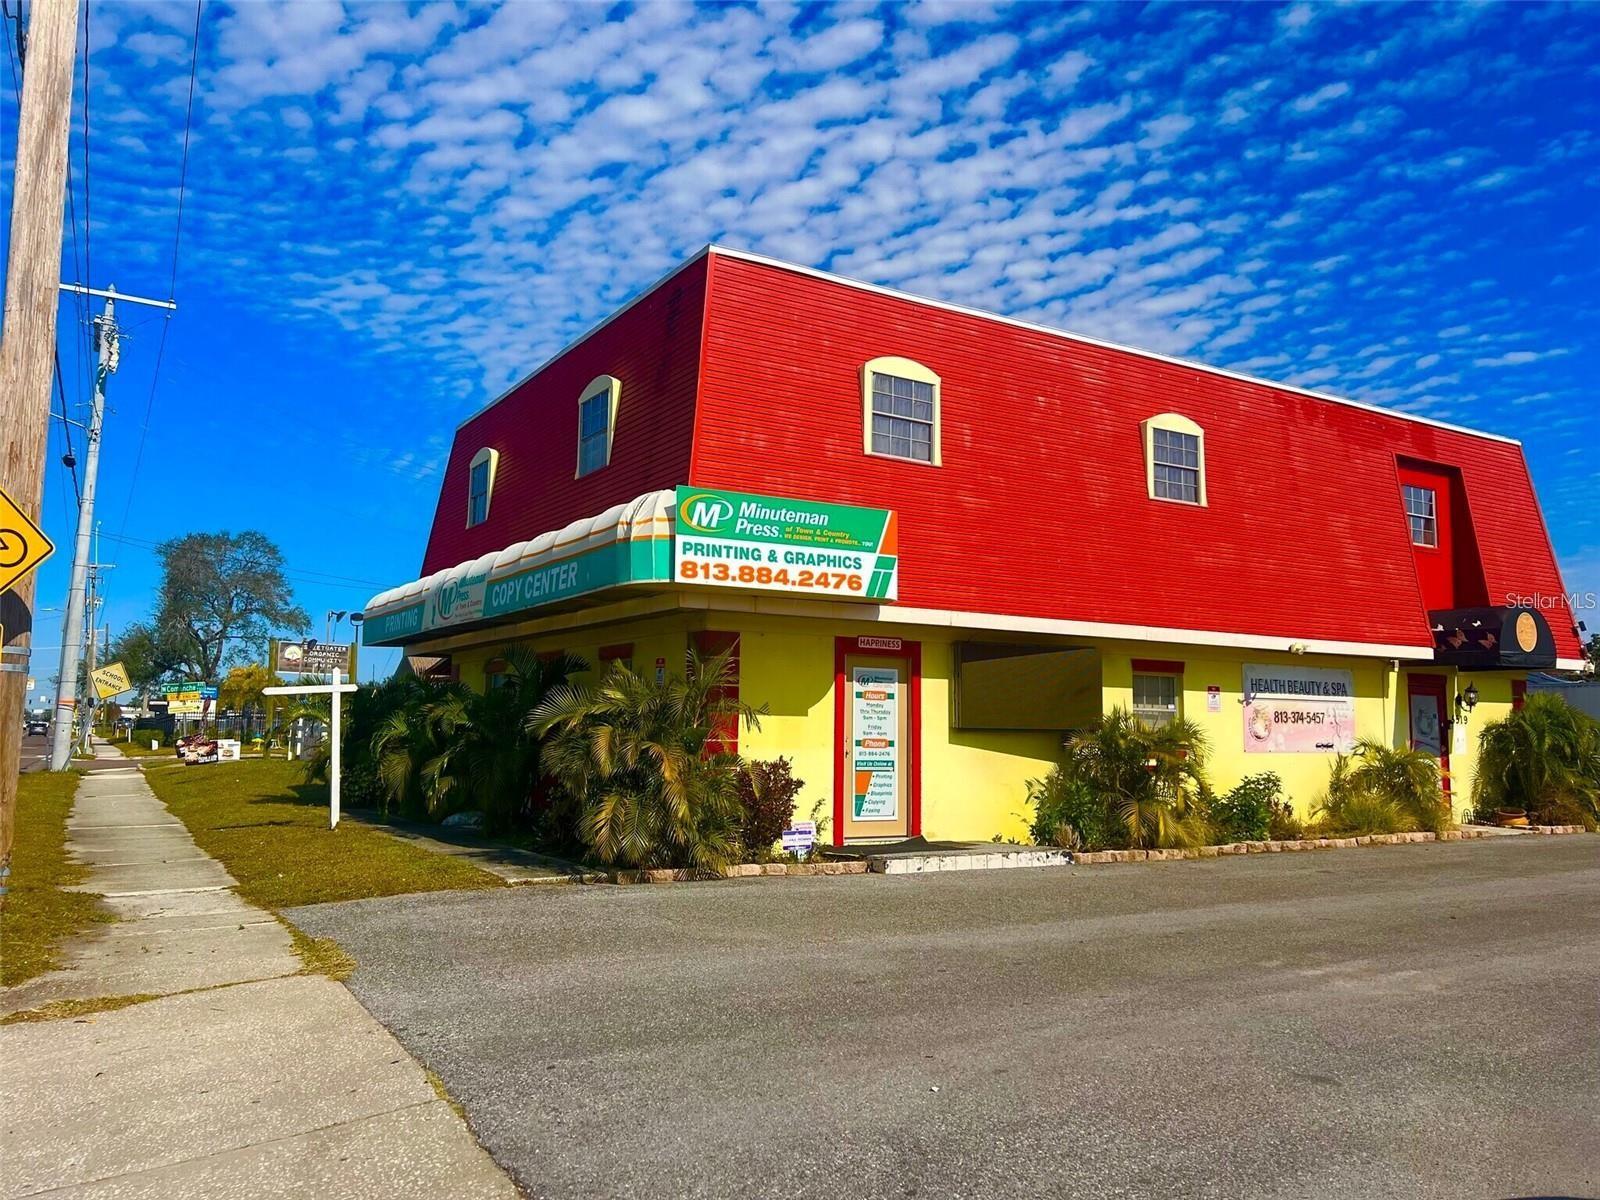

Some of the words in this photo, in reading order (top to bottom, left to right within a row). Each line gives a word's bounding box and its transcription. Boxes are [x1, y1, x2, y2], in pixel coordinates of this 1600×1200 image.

[738, 501, 829, 526] Minuteman
[823, 530, 850, 539] Country
[682, 541, 762, 562] PRINTING
[767, 549, 778, 563] &
[784, 551, 863, 570] GRAPHICS
[680, 560, 863, 592] 813.884.2476
[492, 578, 524, 608] COPY
[525, 562, 578, 599] CENTER
[385, 608, 419, 633] PRINTING
[860, 638, 900, 649] HAPPINESS
[102, 670, 124, 683] SCHOOL
[95, 677, 122, 691] ENTRANCE
[1250, 678, 1286, 693] HEALTH
[1287, 680, 1323, 695] BEAUTY
[1323, 682, 1331, 695] &
[1331, 682, 1348, 696] SPA
[865, 691, 885, 699] Hours
[1273, 711, 1325, 725] 813-374-5457
[864, 739, 886, 747] Phone
